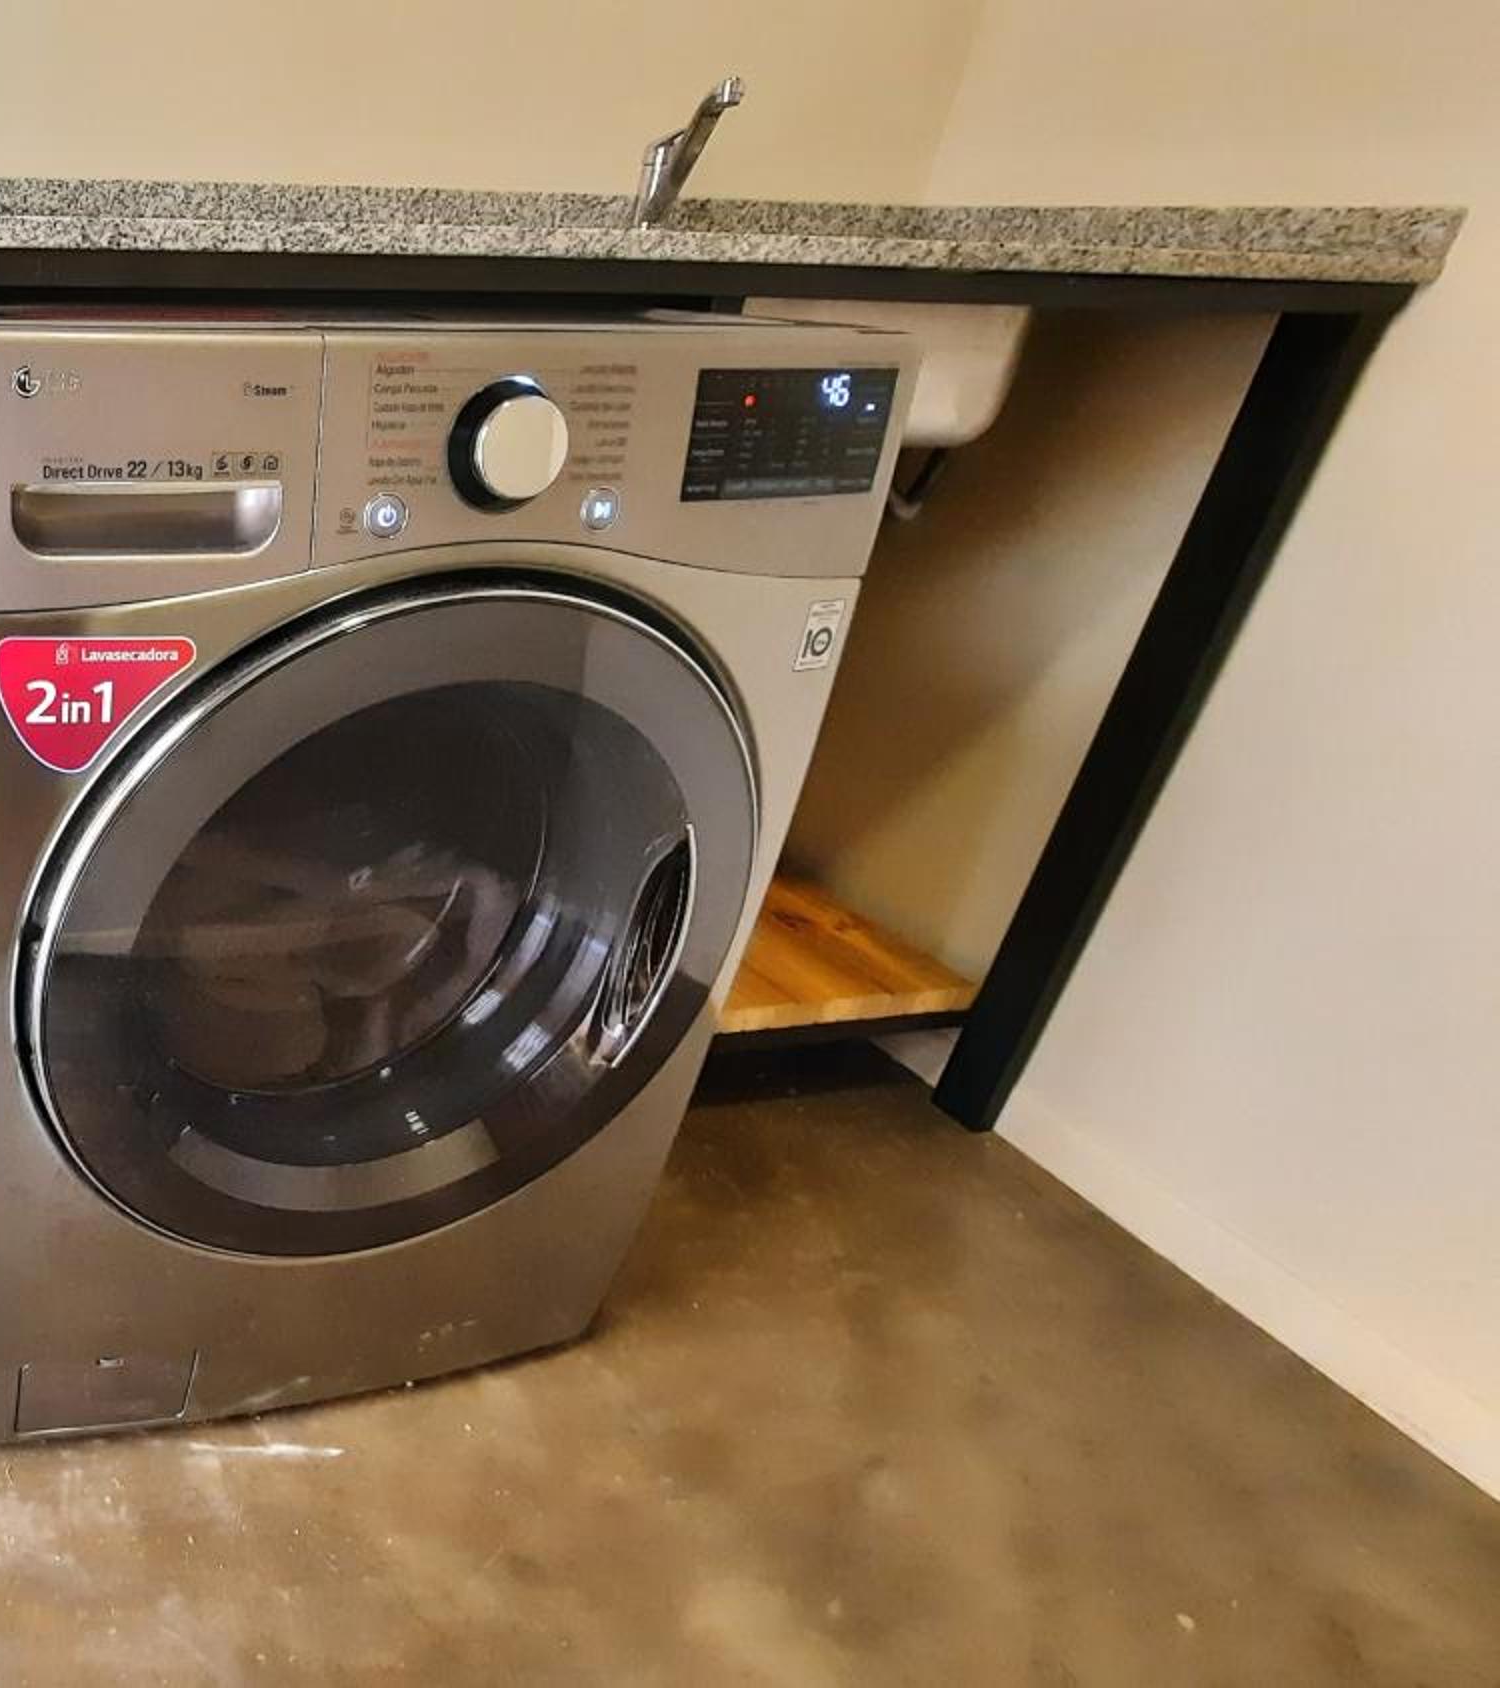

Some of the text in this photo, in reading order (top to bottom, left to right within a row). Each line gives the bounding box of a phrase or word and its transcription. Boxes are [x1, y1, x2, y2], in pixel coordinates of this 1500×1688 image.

[821, 373, 851, 407] 46
[43, 464, 84, 479] Direct
[87, 464, 123, 479] Drive
[127, 460, 148, 478] 22
[167, 460, 203, 480] 13kg
[81, 647, 179, 662] Lavasecadora
